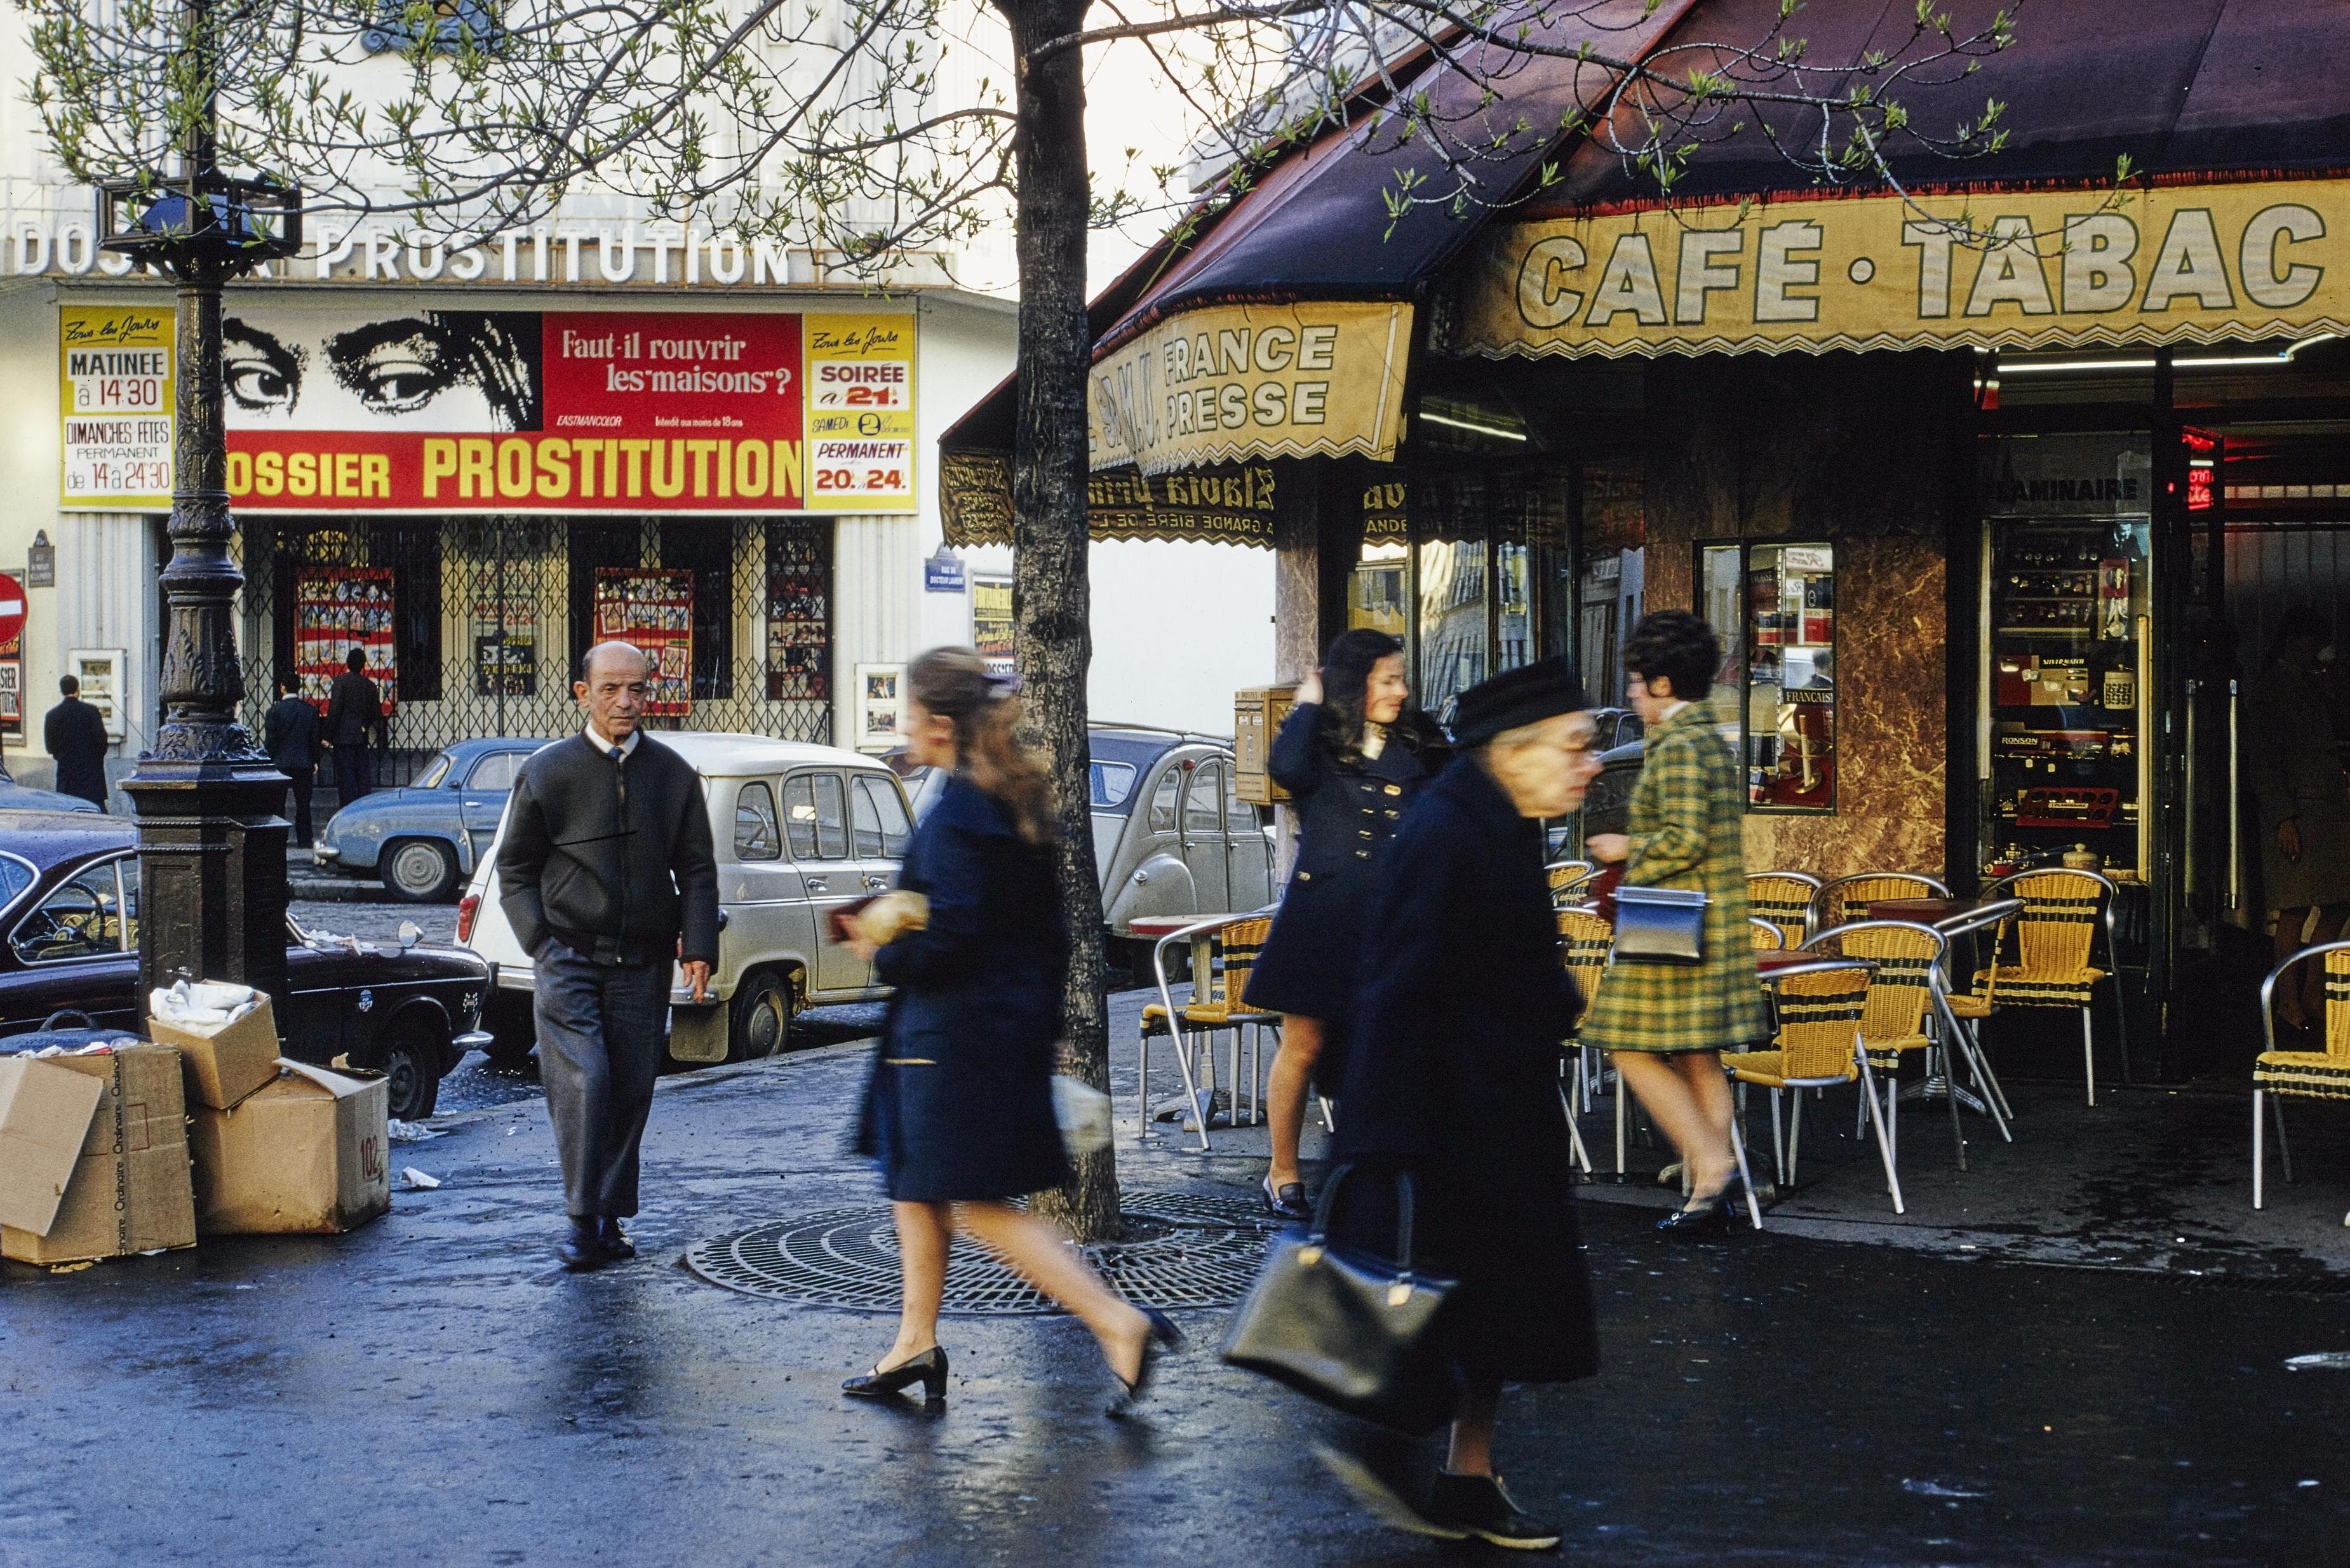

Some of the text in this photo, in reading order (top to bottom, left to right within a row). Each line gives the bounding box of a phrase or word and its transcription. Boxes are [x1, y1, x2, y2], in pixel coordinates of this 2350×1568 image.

[318, 225, 789, 285] PROSTITUTION
[1516, 203, 2326, 330] CAFÉ TABAC
[562, 330, 746, 360] Faut-il rouvrir
[1164, 325, 1338, 387] FRANCE
[70, 353, 164, 375] MATINEE
[606, 363, 644, 392] les
[821, 363, 904, 382] SOIRÉE
[556, 415, 622, 426] EASTMANCOLOR
[655, 416, 679, 427] Interdit
[1167, 382, 1329, 439] PRESSE
[67, 422, 131, 444] DIMANCHES
[77, 447, 159, 459] PERMANENT
[817, 443, 905, 458] PERMANENT
[67, 471, 84, 489] de
[226, 438, 802, 498] OSSIER PROSTITUTION
[112, 1103, 123, 1155] Ordinaire
[114, 1161, 125, 1210] Ordinaire
